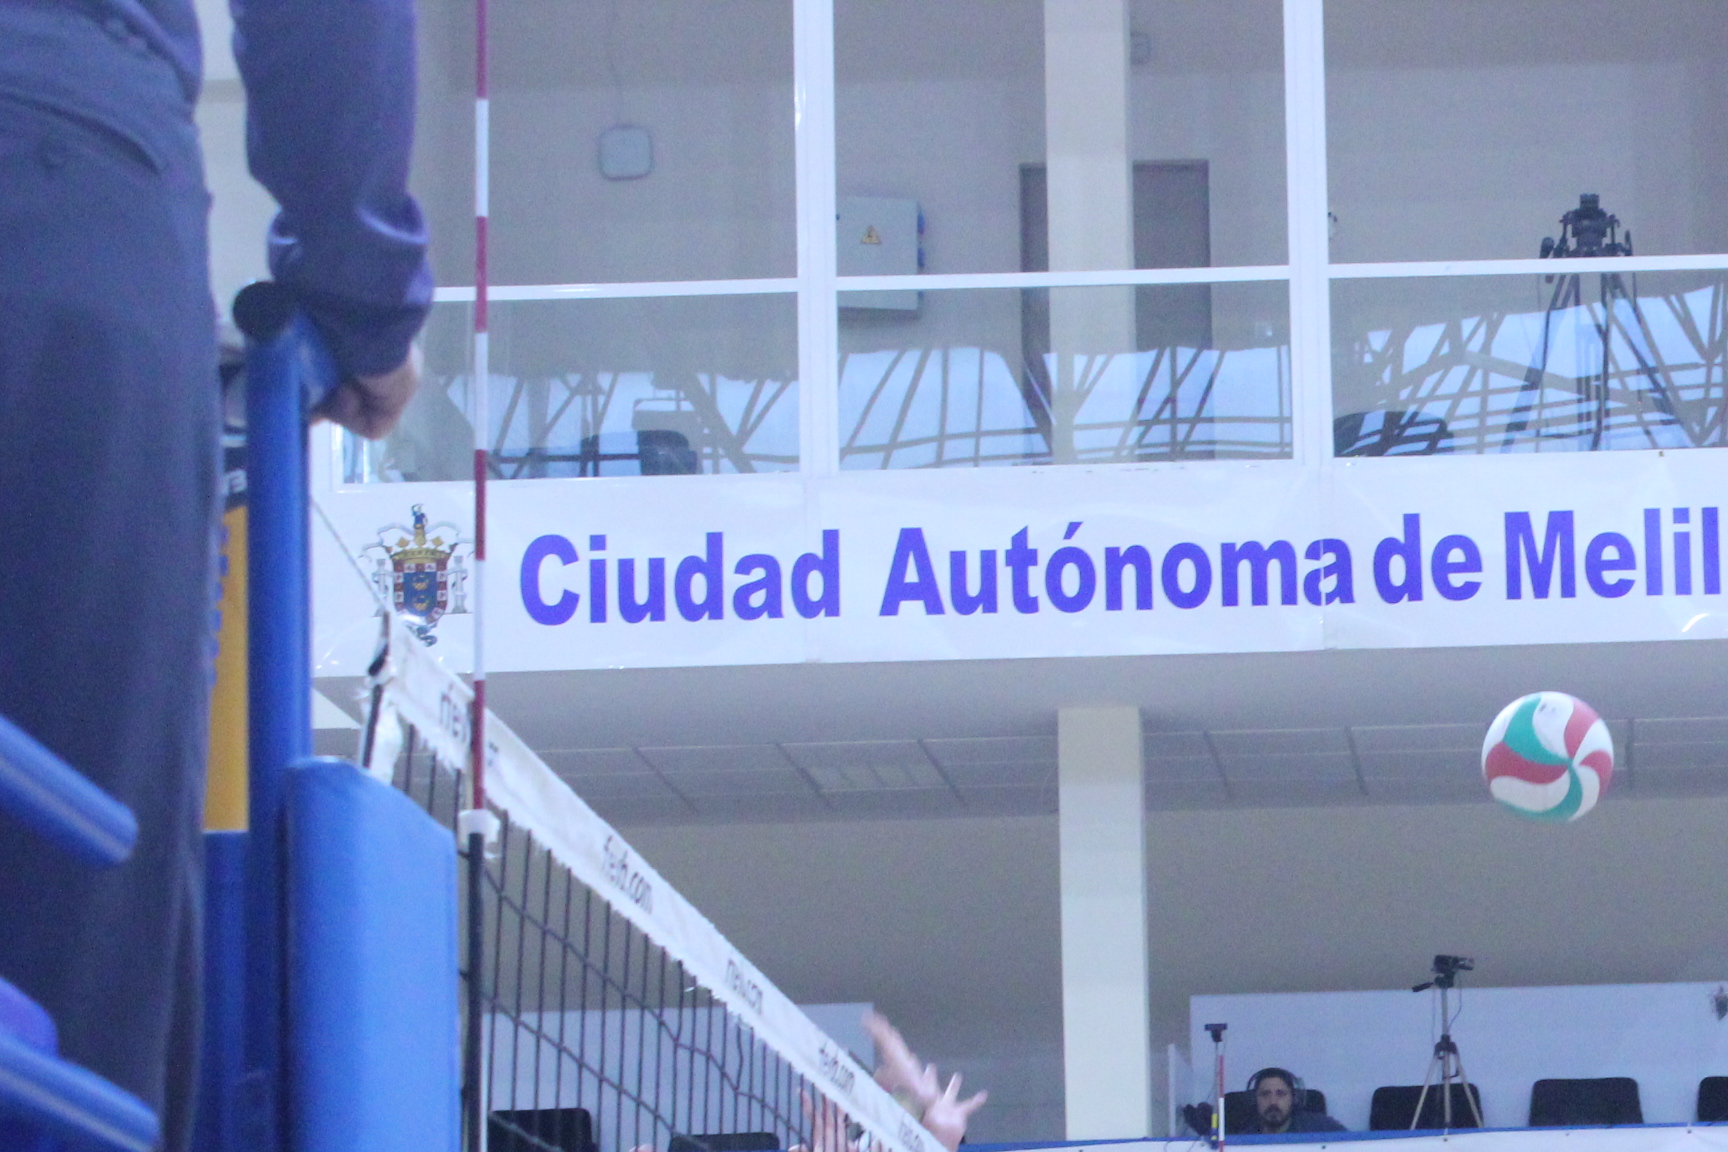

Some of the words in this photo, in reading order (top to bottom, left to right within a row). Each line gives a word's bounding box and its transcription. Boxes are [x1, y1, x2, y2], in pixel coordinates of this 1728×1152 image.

[520, 529, 840, 626] Ciudad
[880, 521, 1355, 617] Autónoma
[1372, 513, 1482, 604] de
